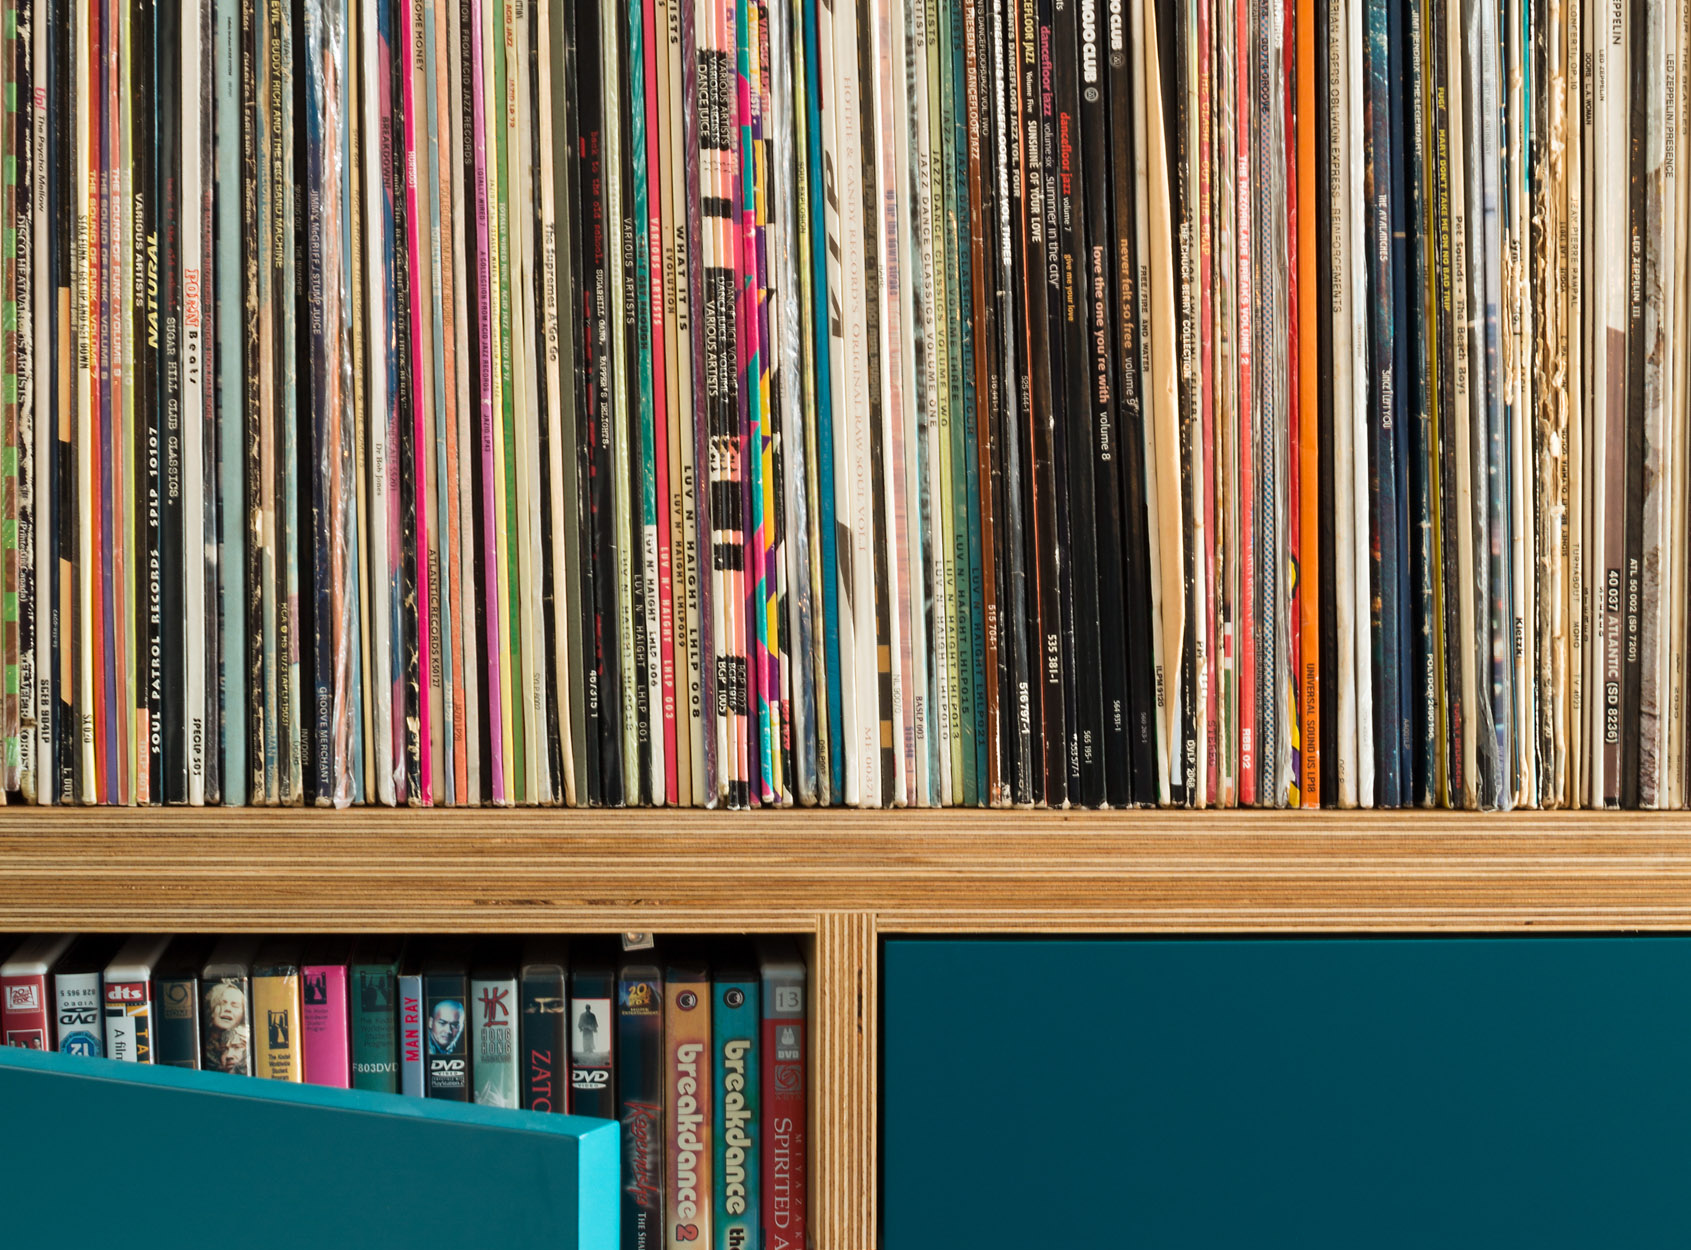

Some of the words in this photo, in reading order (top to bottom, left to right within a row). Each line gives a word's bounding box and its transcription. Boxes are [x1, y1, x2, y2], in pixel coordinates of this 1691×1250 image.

[1666, 54, 1674, 72] LED
[698, 64, 709, 104] DANCE
[34, 87, 47, 111] Up!
[698, 107, 710, 136] JUICE
[37, 135, 45, 171] Psycho
[1028, 120, 1041, 169] SUNSHINE
[1060, 112, 1073, 170] dancefloor
[1439, 129, 1447, 157] MARY
[1030, 172, 1040, 185] OF
[1239, 155, 1248, 178] THE
[1439, 160, 1448, 188] DON'T
[1060, 173, 1073, 195] jazz
[310, 189, 319, 220] JIMMY
[1030, 188, 1042, 214] YOUR
[1063, 197, 1072, 224] volume
[1379, 194, 1387, 207] THE
[1440, 191, 1448, 216] TAKE
[135, 193, 143, 250] VARIOUS
[1031, 218, 1041, 243] LOVE
[1239, 181, 1249, 256] RAZORBLADE
[1441, 218, 1449, 231] ME
[1454, 216, 1463, 237] Pet
[311, 223, 320, 263] McGRIFF
[545, 223, 555, 244] The
[1379, 210, 1388, 261] AVALANCHES
[1441, 233, 1449, 248] ON
[1632, 235, 1640, 253] LED
[676, 226, 686, 278] WHAT
[1063, 254, 1073, 269] give
[1092, 246, 1105, 273] love
[1120, 239, 1132, 274] never
[1455, 241, 1465, 283] Sounds
[135, 253, 143, 307] ARTISTS
[147, 231, 158, 349] NATURAL
[311, 273, 321, 305] STUMP
[545, 248, 557, 308] Supremes
[1095, 276, 1106, 298] the
[1121, 278, 1134, 301] felt
[1239, 258, 1249, 304] BREAKS
[1442, 267, 1450, 287] BAD
[1632, 258, 1641, 301] ZEPPELIN
[678, 288, 686, 305] IT
[1065, 286, 1074, 303] your
[1443, 290, 1451, 311] TRIP
[312, 307, 322, 335] JUICE
[679, 314, 687, 331] IS
[705, 300, 717, 347] VARIOUS
[1066, 305, 1076, 322] love
[1095, 302, 1105, 327] one
[1122, 304, 1133, 319] so
[1456, 299, 1466, 321] The
[1632, 306, 1641, 318] III
[166, 317, 177, 356] SUGAR
[1123, 323, 1135, 348] free
[1240, 307, 1249, 355] VOLUME
[1457, 326, 1467, 361] Beach
[549, 346, 559, 362] Go
[1240, 357, 1249, 365] 2
[167, 361, 178, 395] HILL
[707, 350, 719, 396] ARTISTS
[1124, 357, 1136, 395] volume
[1456, 366, 1467, 395] Boys
[1098, 375, 1110, 403] with
[167, 398, 178, 430] CLUB
[1099, 412, 1110, 450] volume
[168, 437, 178, 505] CLASSICS.
[684, 466, 694, 499] LUV
[375, 475, 383, 496] Jones
[151, 549, 159, 624] RECORDS
[687, 541, 697, 610] HAIGHT
[1608, 570, 1618, 586] 40
[1608, 588, 1618, 611] 037
[690, 629, 699, 672] LHLP
[1608, 616, 1619, 677] ATLANTIC
[151, 636, 160, 699] PATROL
[691, 682, 701, 718] 008
[1305, 663, 1315, 716] UNIVERSAL
[1607, 682, 1618, 705] (SD
[318, 686, 328, 727] GROOVE
[151, 711, 160, 754] SOUL
[1306, 720, 1315, 753] SOUND
[1606, 708, 1619, 744] 8236)
[320, 730, 329, 784] MERCHANT
[1306, 755, 1315, 769] US
[1306, 771, 1316, 792] LP18
[108, 985, 141, 1000] dts
[779, 991, 799, 1007] 13
[60, 1013, 97, 1025] DVD
[405, 997, 419, 1025] RAY
[405, 1032, 420, 1061] MAN
[778, 1050, 799, 1058] DVD
[431, 1060, 465, 1070] DVD
[573, 1070, 609, 1082] DVD
[677, 1043, 703, 1218] breakdance
[724, 1040, 751, 1215] breakdance
[624, 1101, 662, 1206] Kagemusha
[774, 1118, 792, 1228] SPIRITED
[638, 1212, 647, 1230] THE
[676, 1224, 698, 1242] 2
